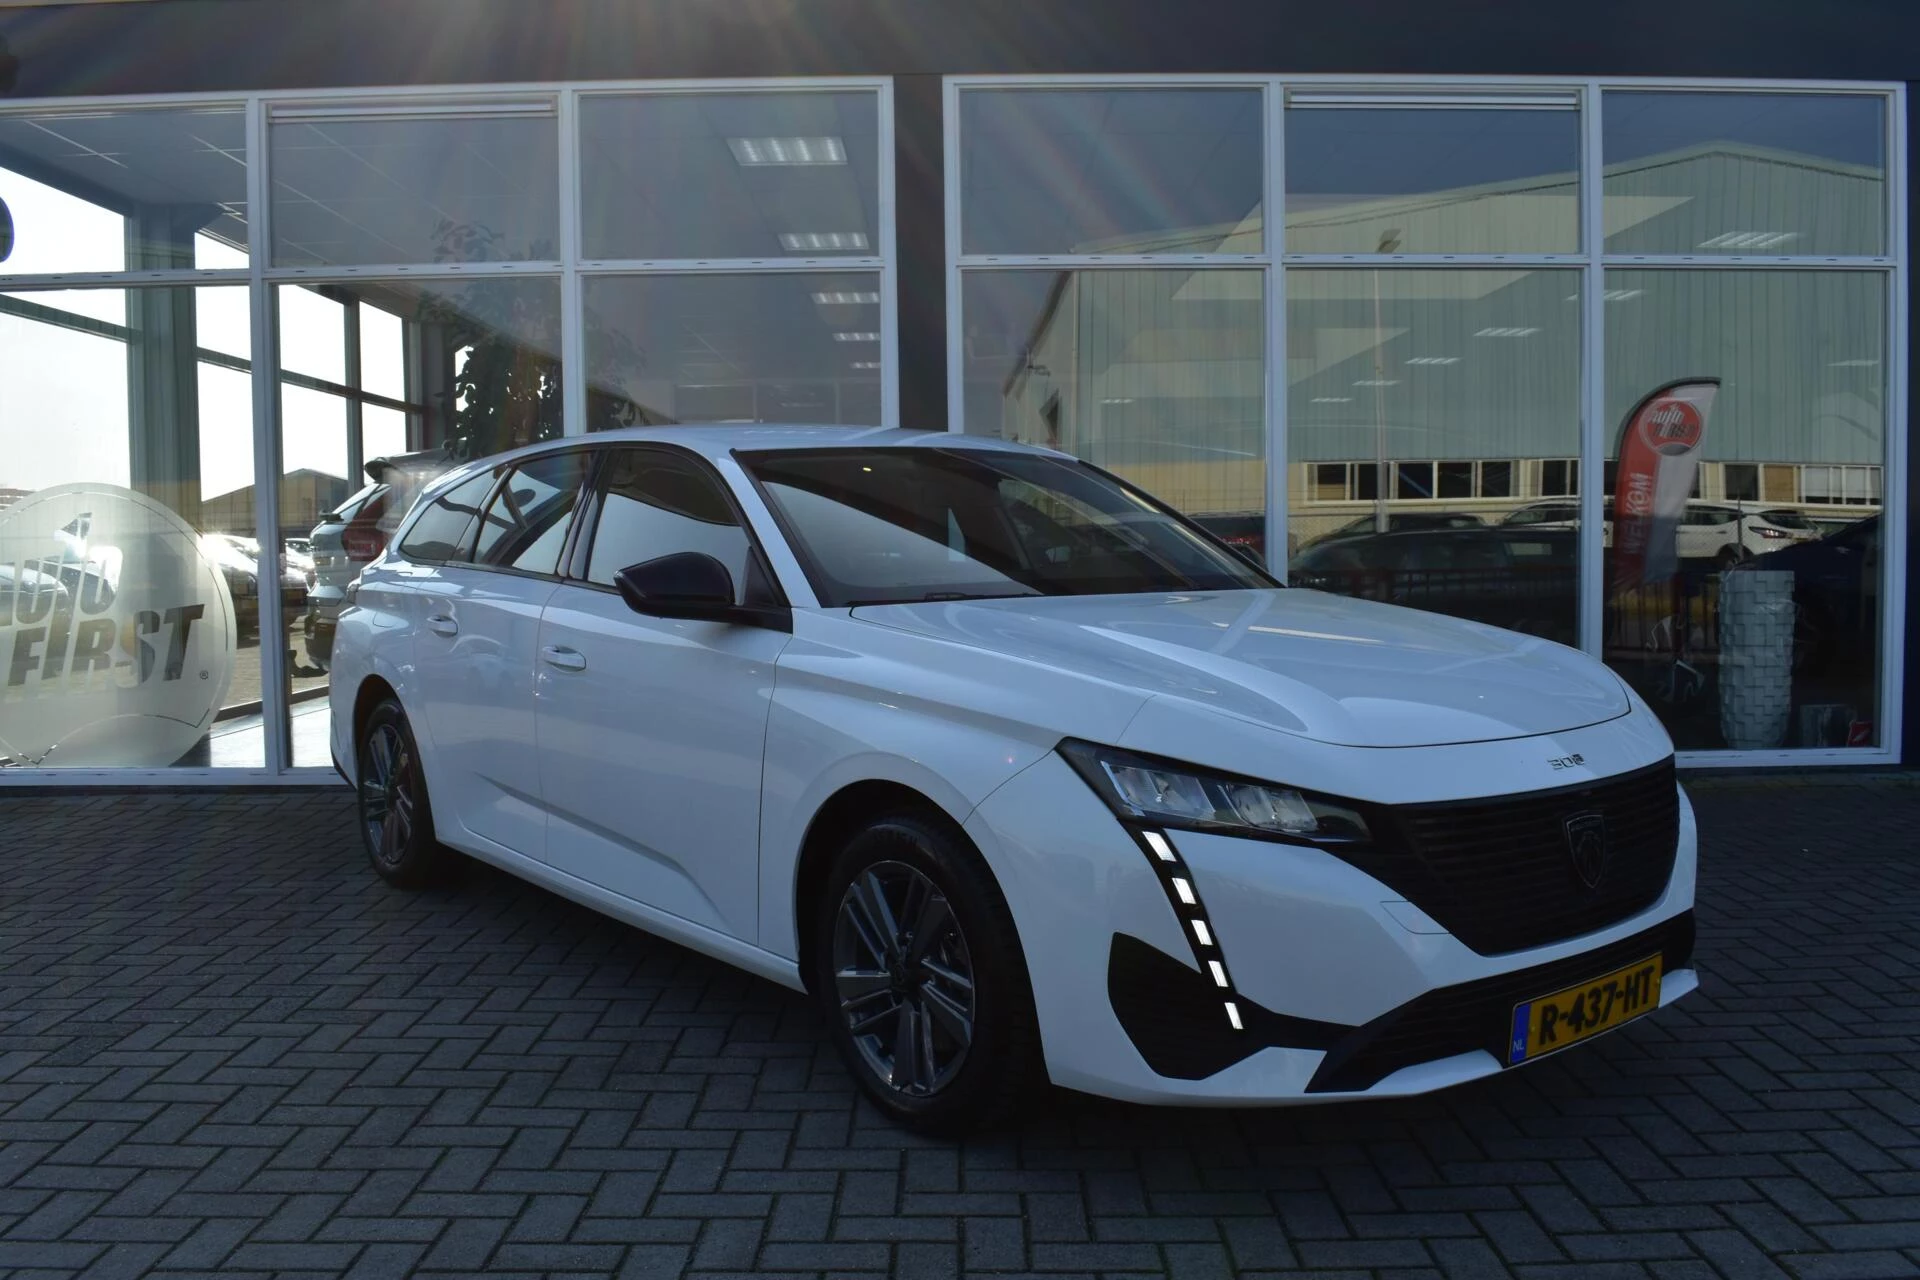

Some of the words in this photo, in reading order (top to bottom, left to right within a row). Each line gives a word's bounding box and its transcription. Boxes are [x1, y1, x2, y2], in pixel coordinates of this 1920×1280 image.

[1623, 472, 1653, 555] WELKOM
[8, 603, 205, 689] FIRST
[1547, 753, 1584, 770] 308
[1539, 965, 1655, 1046] R-437-HT
[1512, 1039, 1525, 1054] NL
